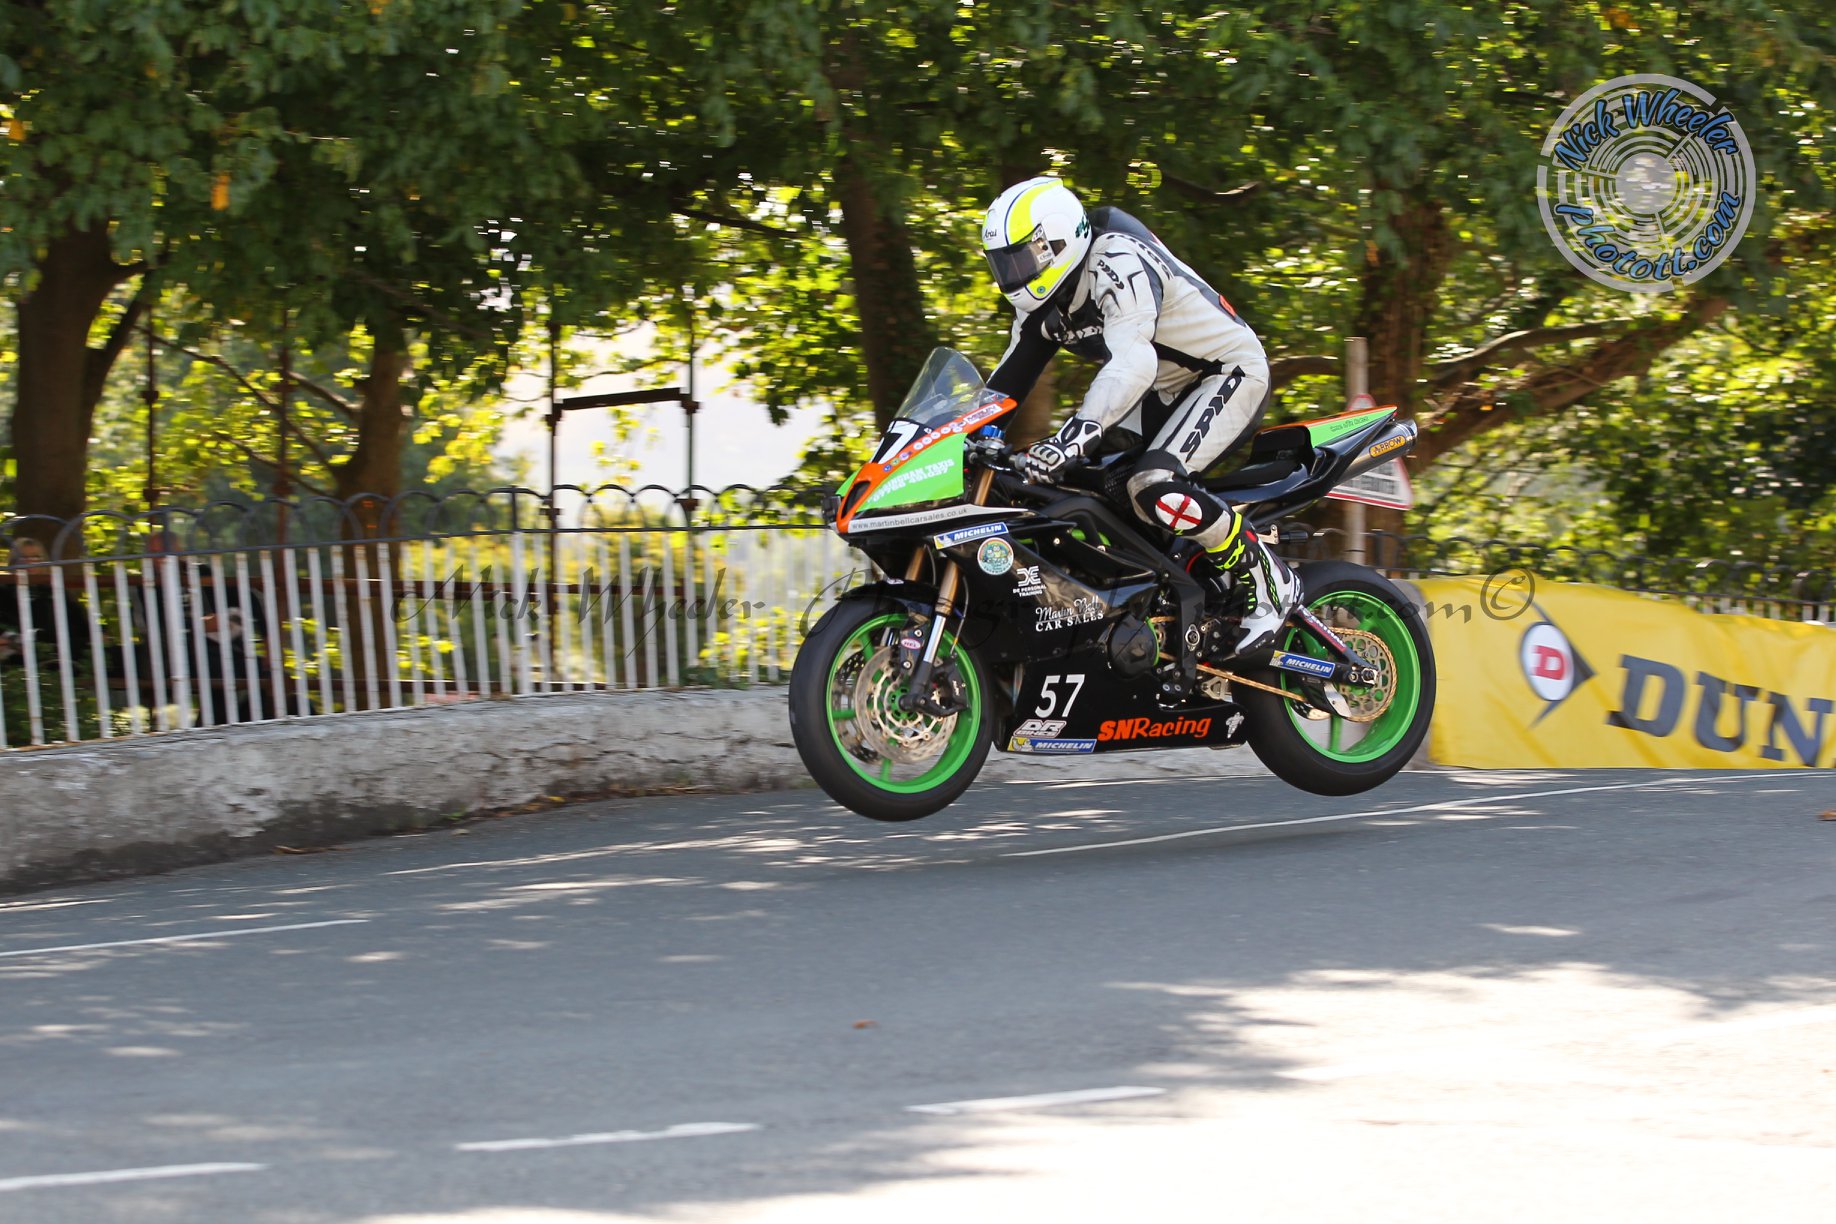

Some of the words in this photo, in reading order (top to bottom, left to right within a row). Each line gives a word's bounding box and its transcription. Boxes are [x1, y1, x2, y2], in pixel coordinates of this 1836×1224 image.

[1180, 365, 1245, 463] SPIDI
[954, 524, 1002, 541] MICHELIN
[1035, 619, 1063, 632] CAR
[1067, 610, 1104, 624] SALES
[1286, 658, 1332, 674] MICHELIN
[1531, 645, 1566, 682] D
[1035, 674, 1086, 719] 57
[1606, 653, 1836, 768] DUN
[1097, 716, 1212, 741] SNRacing
[1035, 742, 1094, 750] MICHELIN
